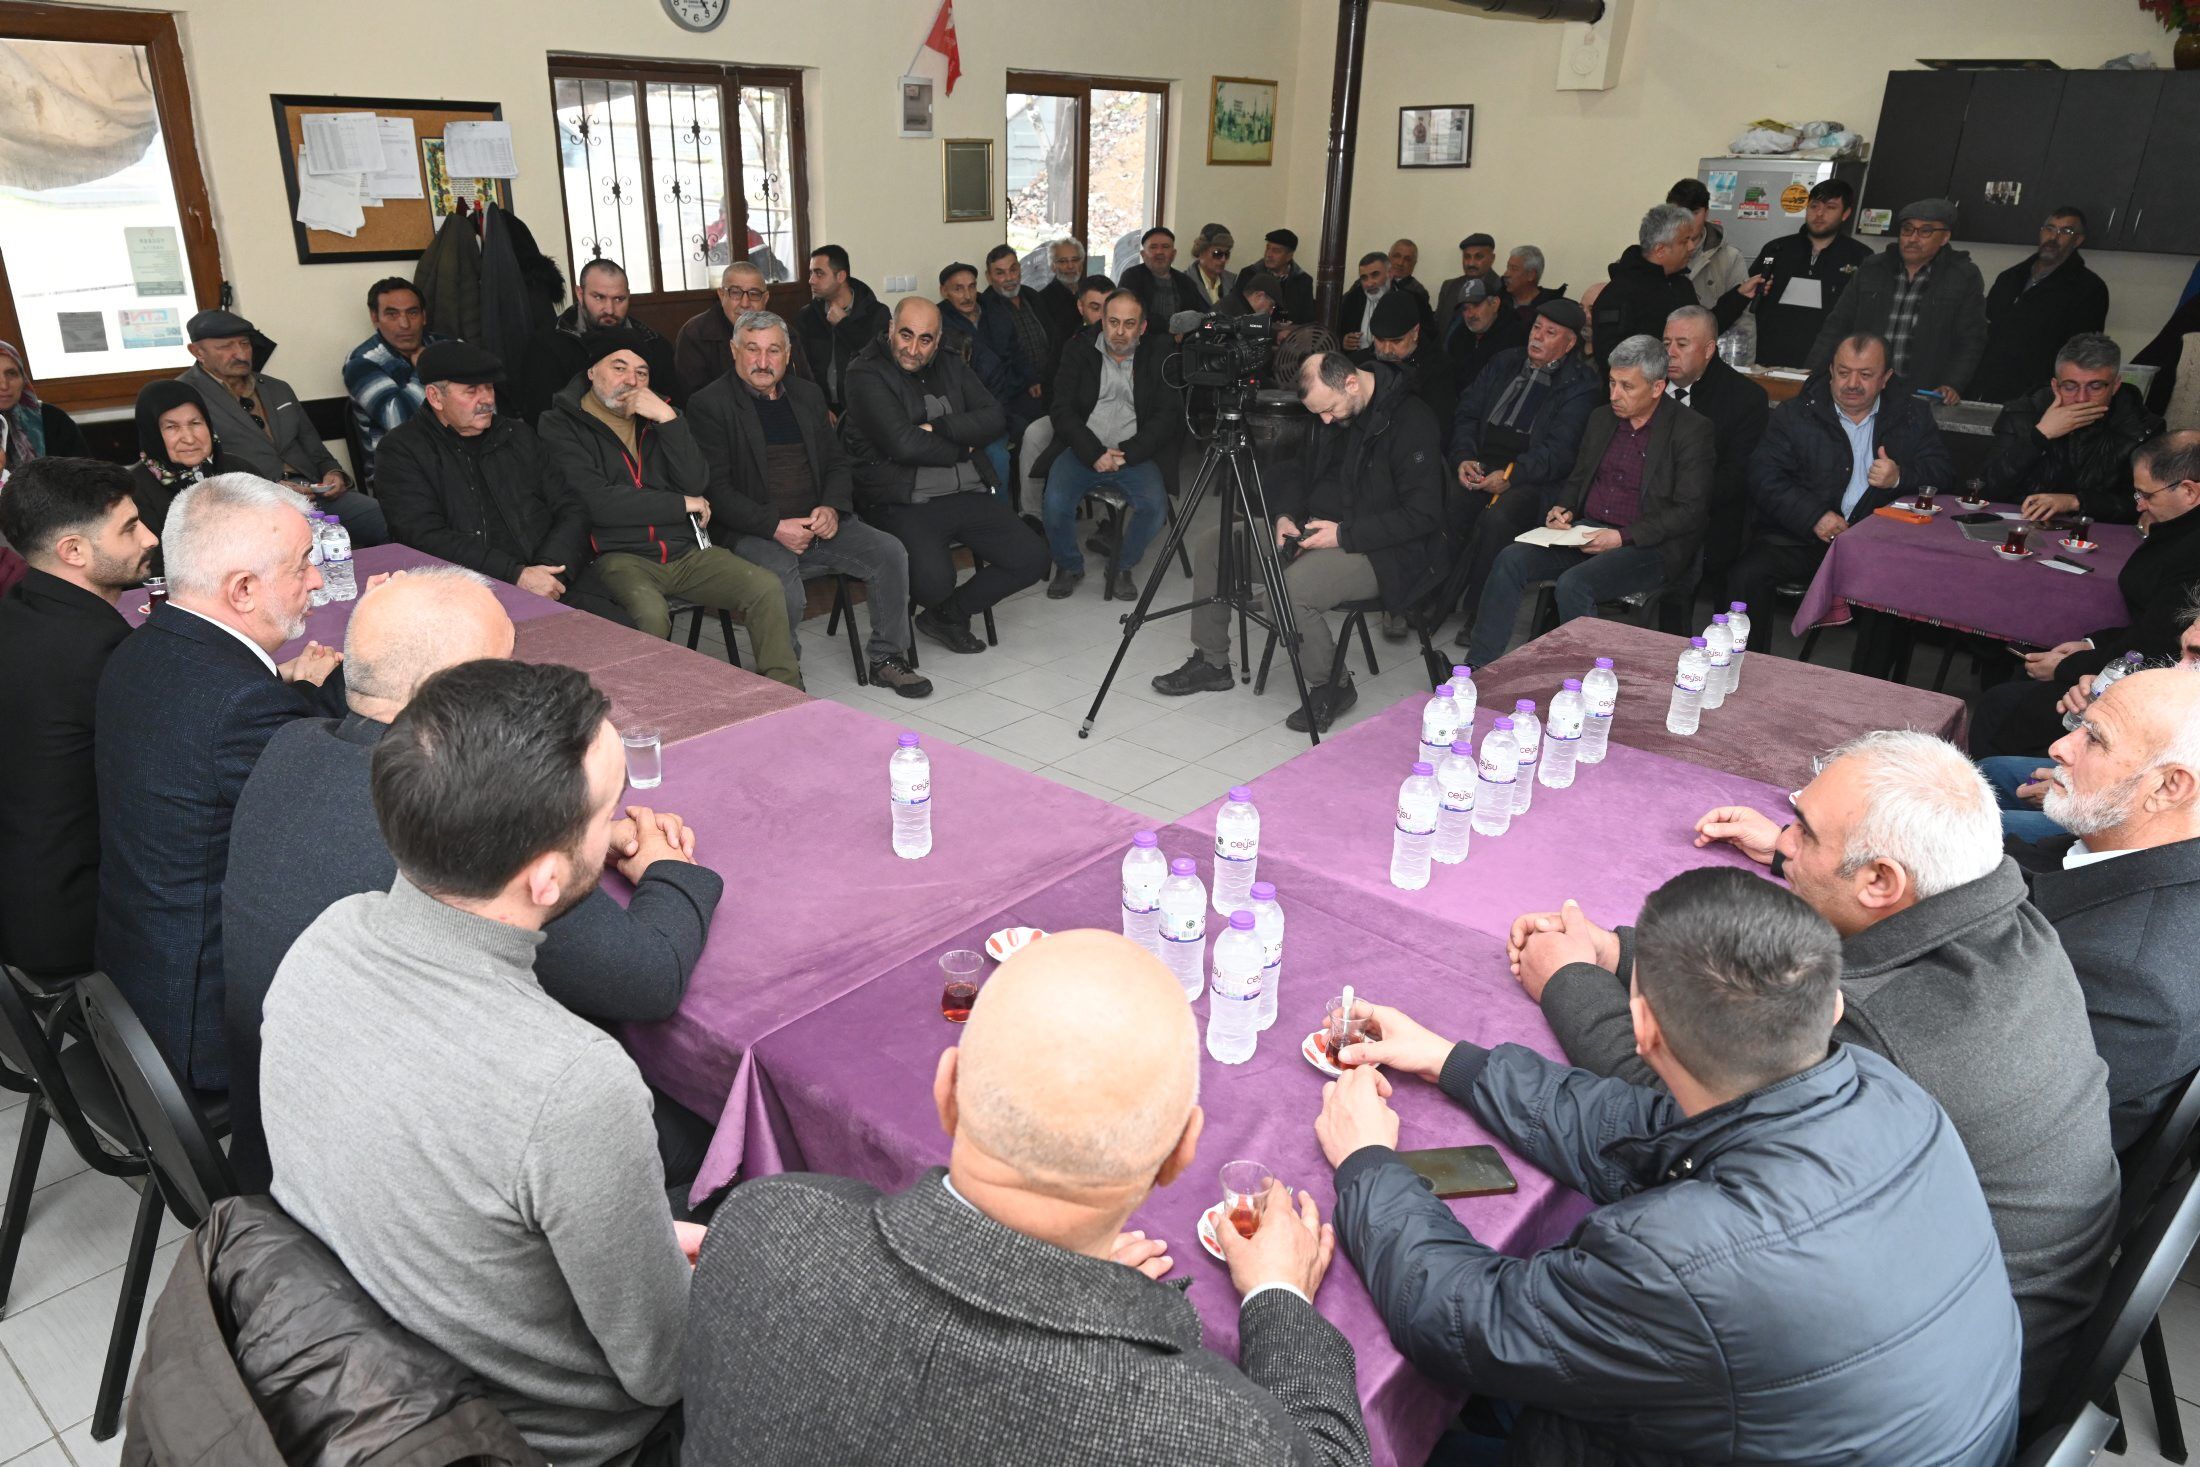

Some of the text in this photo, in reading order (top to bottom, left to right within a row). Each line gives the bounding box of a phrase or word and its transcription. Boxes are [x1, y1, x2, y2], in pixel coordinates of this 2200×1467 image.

[712, 1, 718, 9] 4
[681, 8, 687, 16] 7
[704, 9, 710, 18] 5
[693, 13, 700, 22] 6
